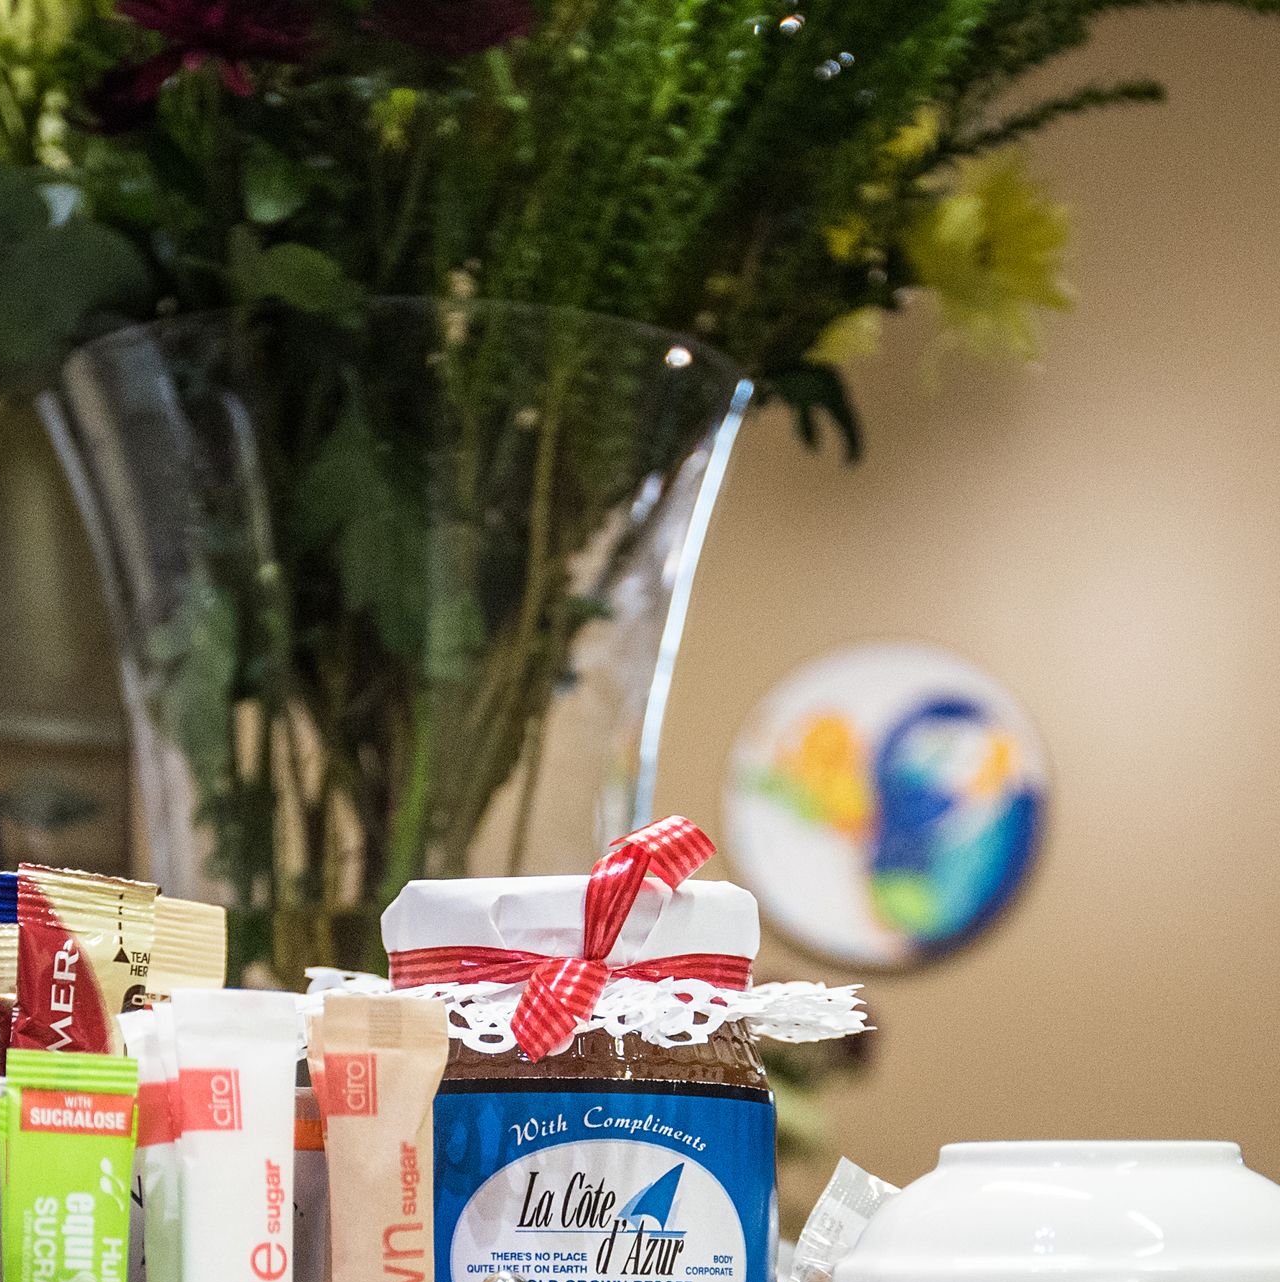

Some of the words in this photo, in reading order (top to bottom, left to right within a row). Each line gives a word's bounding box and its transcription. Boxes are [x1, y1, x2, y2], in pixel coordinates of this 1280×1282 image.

[130, 964, 148, 977] HER
[64, 1096, 93, 1109] WITH
[208, 1074, 231, 1126] ciro
[347, 1060, 366, 1110] ciro
[29, 1107, 127, 1131] SUCRALOSE
[508, 1109, 569, 1147] With
[583, 1105, 708, 1153] Compliments
[400, 1140, 420, 1216] sugar
[265, 1158, 285, 1235] sugar
[516, 1170, 554, 1229] La
[560, 1171, 616, 1229] Côte
[490, 1251, 533, 1262] THERE'S
[534, 1251, 551, 1262] NO
[553, 1252, 588, 1262] PLACE
[595, 1217, 685, 1277] d'Azur
[712, 1254, 734, 1264] BODY
[466, 1263, 496, 1274] QUITE
[522, 1264, 531, 1274] IT
[534, 1264, 550, 1274] ON
[552, 1264, 588, 1274] EARTH
[685, 1266, 734, 1277] CORPORATE
